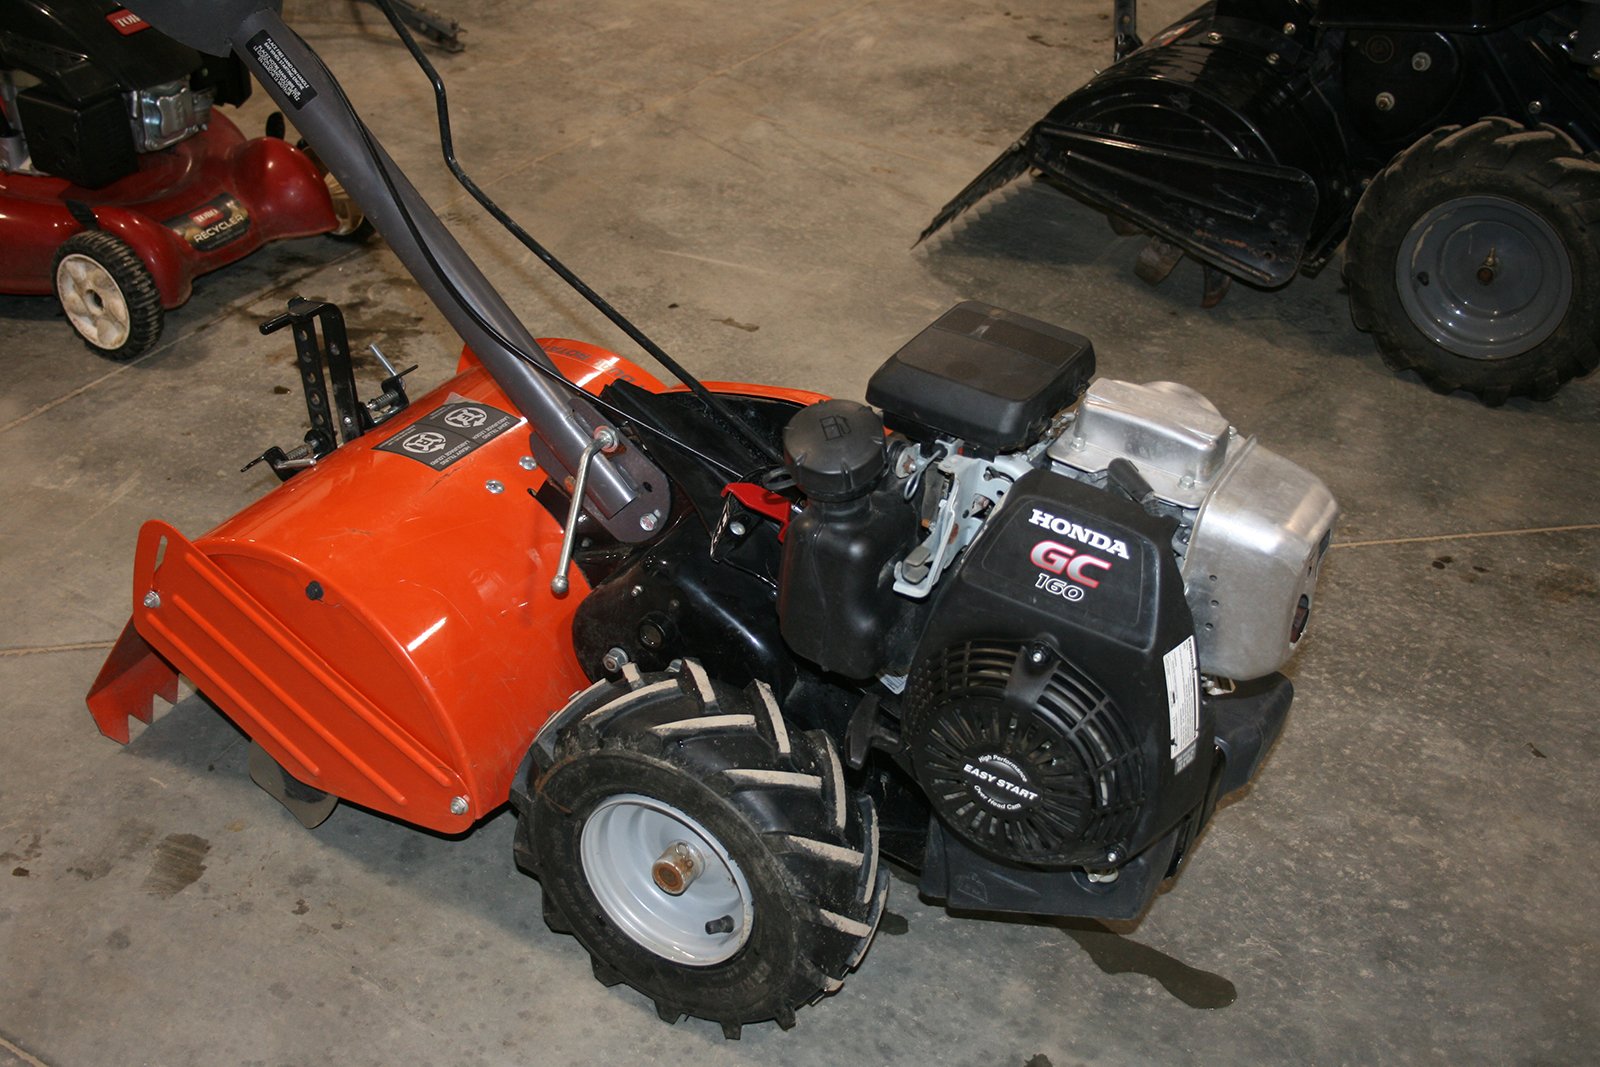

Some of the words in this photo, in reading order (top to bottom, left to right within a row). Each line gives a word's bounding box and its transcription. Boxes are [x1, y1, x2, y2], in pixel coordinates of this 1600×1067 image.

[263, 41, 272, 50] BAR
[269, 49, 280, 61] WHEN
[278, 59, 294, 77] STARTING
[266, 37, 277, 50] PLACE
[275, 48, 284, 58] FREE
[282, 56, 293, 69] HAND
[295, 72, 309, 88] HANDLE
[193, 213, 244, 243] RECYCLER
[481, 428, 498, 439] TILLING
[439, 453, 456, 465] TILLING
[455, 445, 470, 455] HEAVY
[1029, 508, 1129, 559] HONDA
[1029, 541, 1112, 589] GC
[1034, 572, 1083, 602] 160
[963, 763, 997, 782] EASY
[995, 778, 1038, 800] START
[977, 754, 992, 763] High
[993, 754, 1027, 782] Performance
[974, 784, 987, 799] Over
[987, 798, 1005, 809] Head
